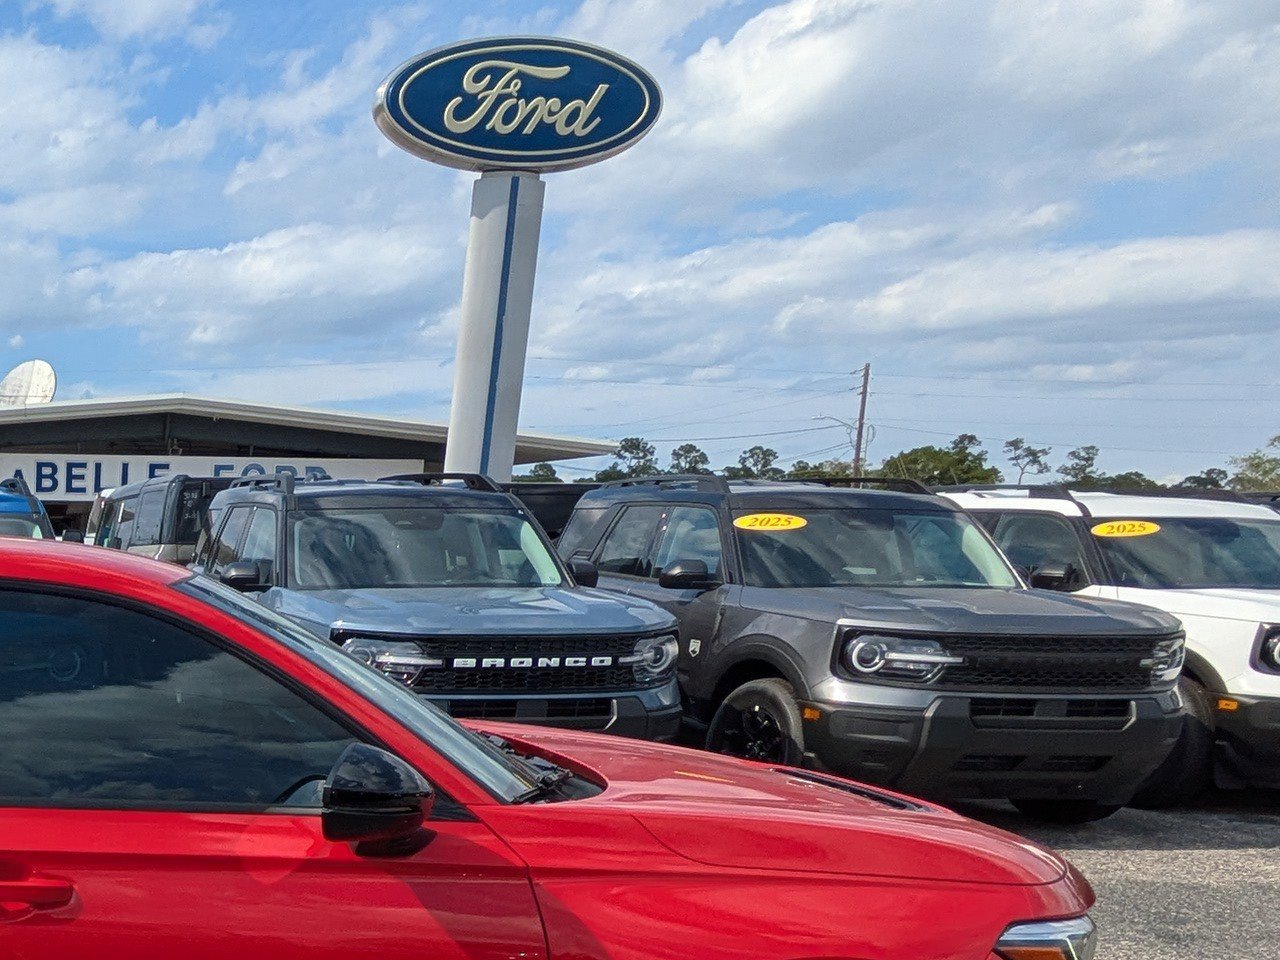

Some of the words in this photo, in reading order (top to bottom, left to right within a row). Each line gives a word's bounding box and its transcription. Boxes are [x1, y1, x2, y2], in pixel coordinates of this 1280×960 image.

[443, 59, 610, 137] Ford
[746, 516, 794, 527] 2025
[1105, 522, 1147, 535] 2025
[453, 657, 613, 668] BRONCO
